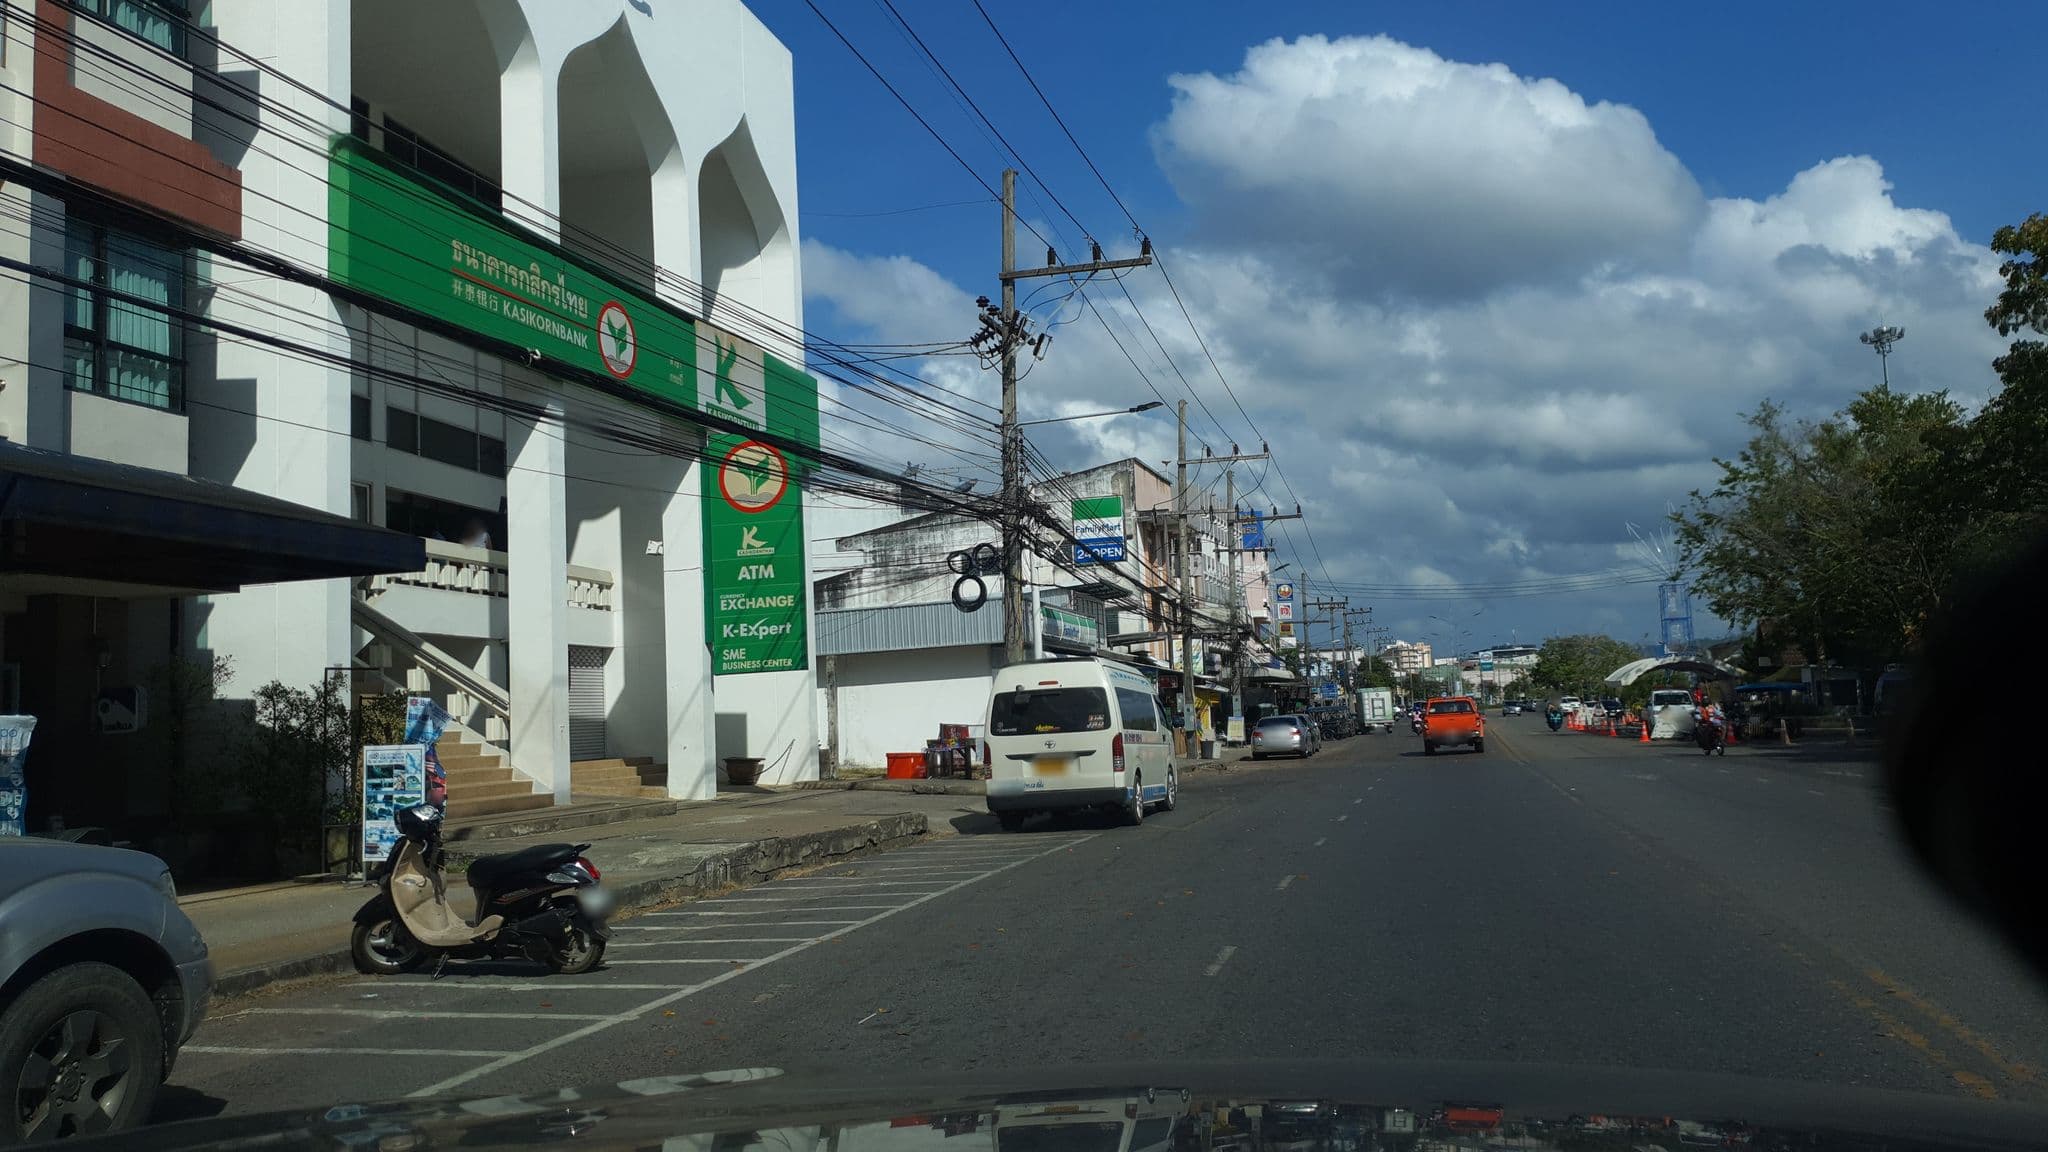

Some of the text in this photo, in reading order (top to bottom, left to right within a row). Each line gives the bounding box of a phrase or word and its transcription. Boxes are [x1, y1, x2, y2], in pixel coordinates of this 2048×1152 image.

[452, 239, 588, 319] ธนาคารกสิกรไทย
[503, 299, 588, 349] KASIKORNBANK
[1092, 547, 1122, 558] OPEN
[738, 564, 775, 580] ATM
[720, 595, 795, 611] EXCHANGE
[723, 618, 792, 639] K-Expert
[723, 649, 746, 660] SME
[722, 658, 793, 670] BUSINESS CENTER
